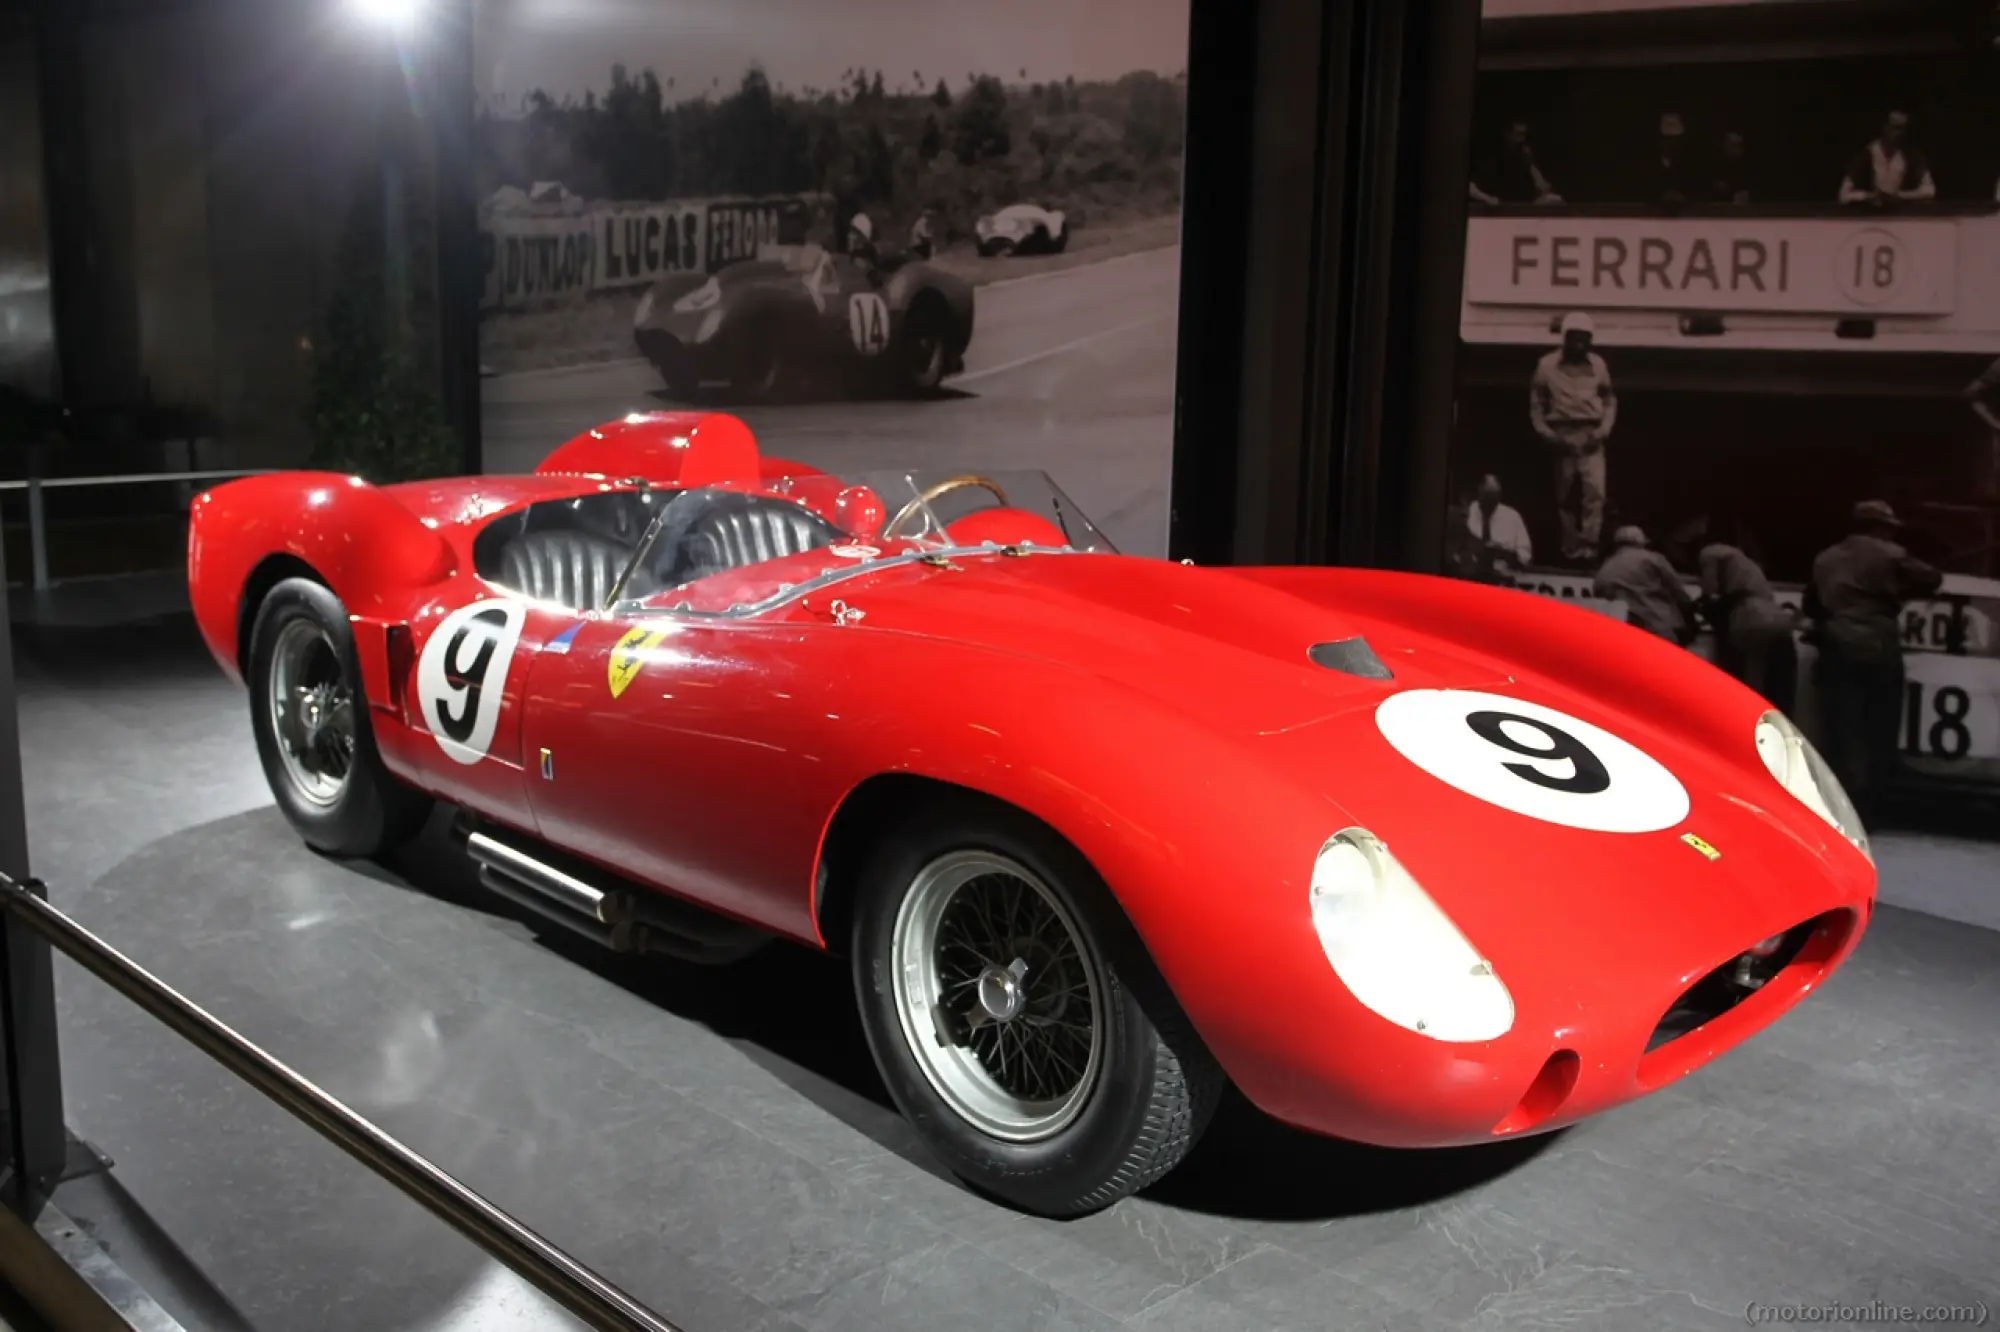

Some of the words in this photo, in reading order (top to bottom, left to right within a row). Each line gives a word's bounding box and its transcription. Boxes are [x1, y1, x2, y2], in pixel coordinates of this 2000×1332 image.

[505, 232, 589, 296] DUNLOP
[605, 211, 698, 279] LUCAS
[1511, 235, 1790, 292] FERRARI
[1853, 244, 1895, 289] 18
[854, 297, 885, 354] 14
[435, 607, 509, 744] 9
[1465, 710, 1611, 794] 9
[1905, 681, 1972, 762] 18
